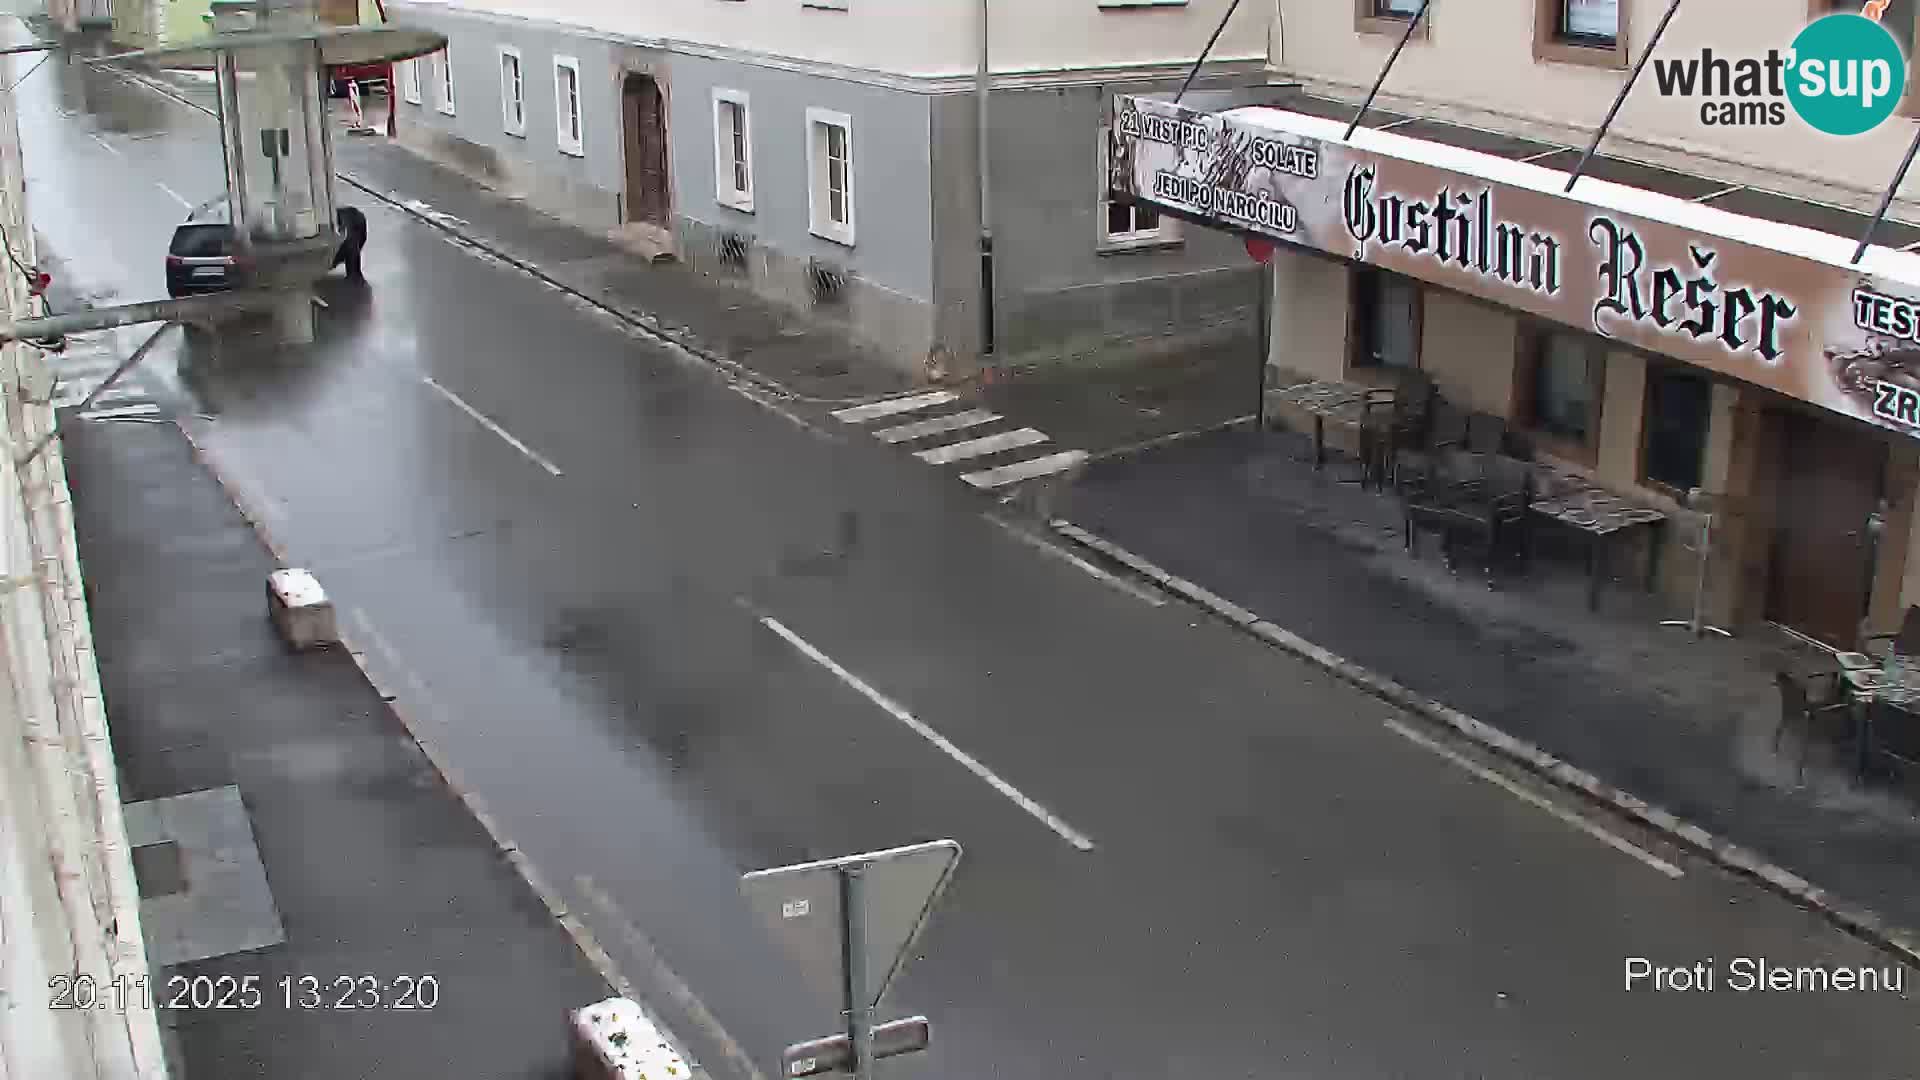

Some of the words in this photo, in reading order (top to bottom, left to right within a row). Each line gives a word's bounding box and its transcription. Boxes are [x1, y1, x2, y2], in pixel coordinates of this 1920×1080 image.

[1121, 111, 1140, 136] 21
[1142, 115, 1179, 145] VRST
[1253, 137, 1318, 179] SOLATE
[1153, 171, 1187, 202] JEDI
[1188, 179, 1211, 209] PO
[1214, 187, 1297, 232] NAROČILU
[1343, 163, 1562, 296] Gostilna
[1589, 215, 1797, 362] Rešer
